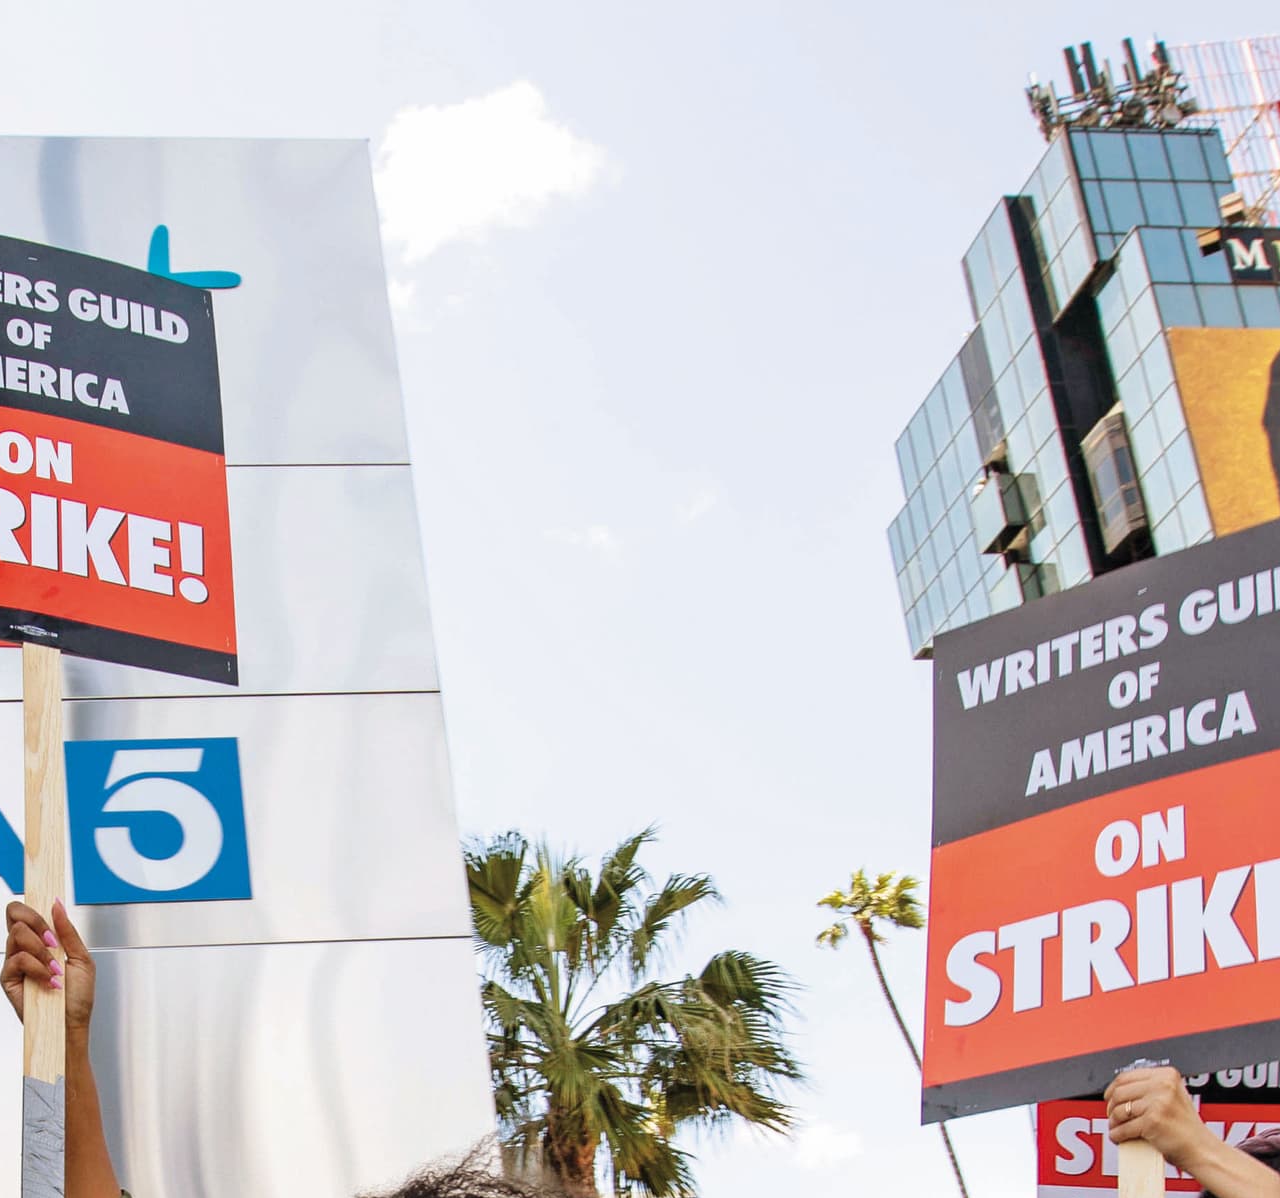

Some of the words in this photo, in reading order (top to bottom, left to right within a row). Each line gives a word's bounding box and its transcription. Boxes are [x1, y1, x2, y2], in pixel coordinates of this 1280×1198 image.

[6, 316, 53, 351] OF
[68, 286, 190, 344] GUILD
[955, 603, 1169, 711] WRITERS
[1107, 661, 1161, 710] OF
[1024, 689, 1258, 798] AMERICA
[93, 747, 224, 892] 5
[1093, 803, 1186, 878] ON
